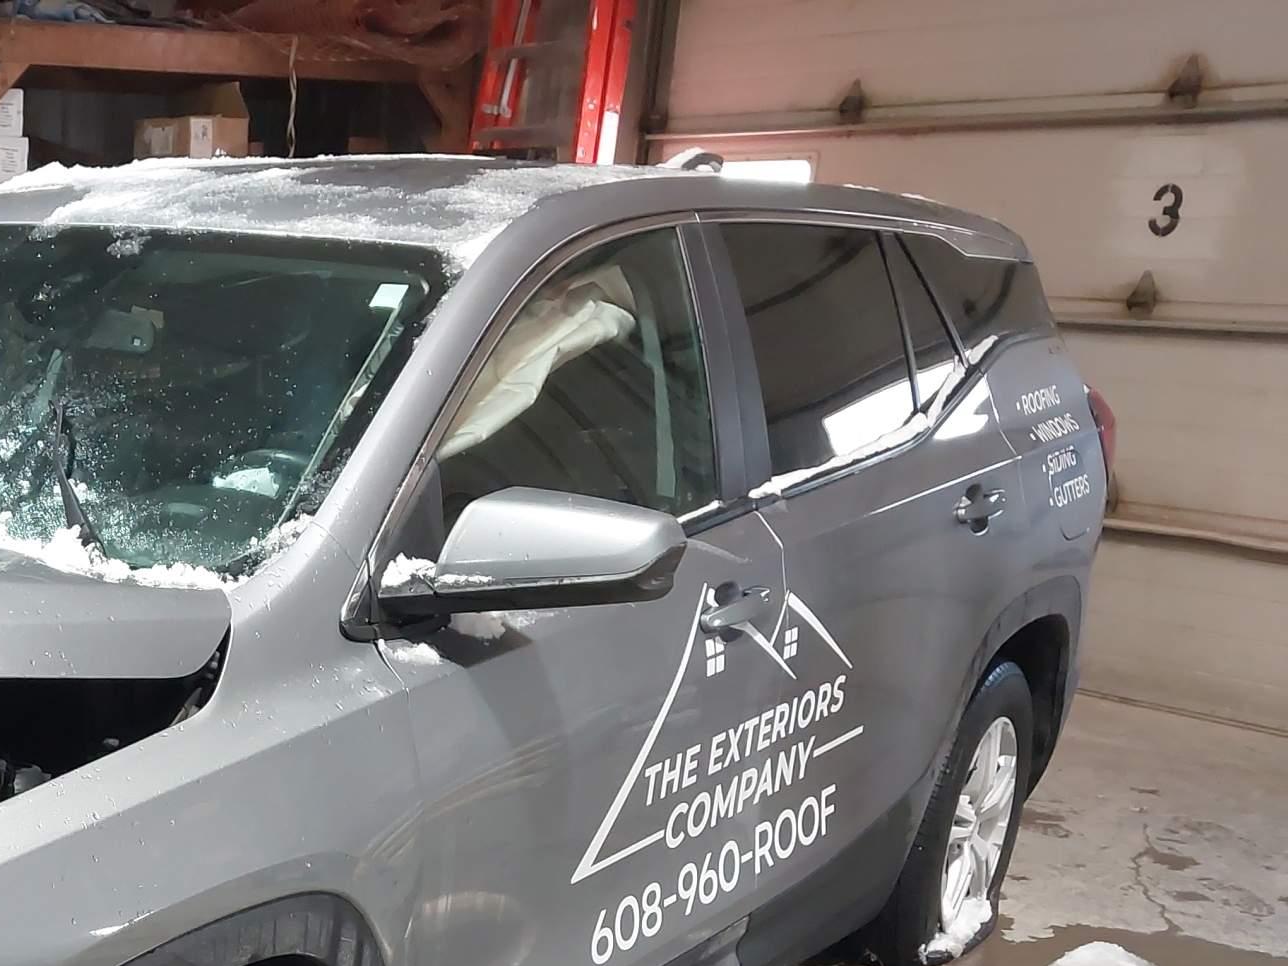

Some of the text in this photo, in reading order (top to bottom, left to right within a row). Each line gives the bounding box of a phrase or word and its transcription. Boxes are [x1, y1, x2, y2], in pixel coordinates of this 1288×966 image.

[1148, 183, 1183, 237] 3
[1021, 385, 1061, 416] ROOFING
[1032, 413, 1080, 443] WINDOWS
[1047, 446, 1077, 475] SIDING
[1053, 475, 1090, 508] GUTTERS
[644, 675, 846, 806] THE EXTERIORS
[665, 736, 815, 849] COMPANY
[591, 784, 836, 965] 608-960-ROOF
